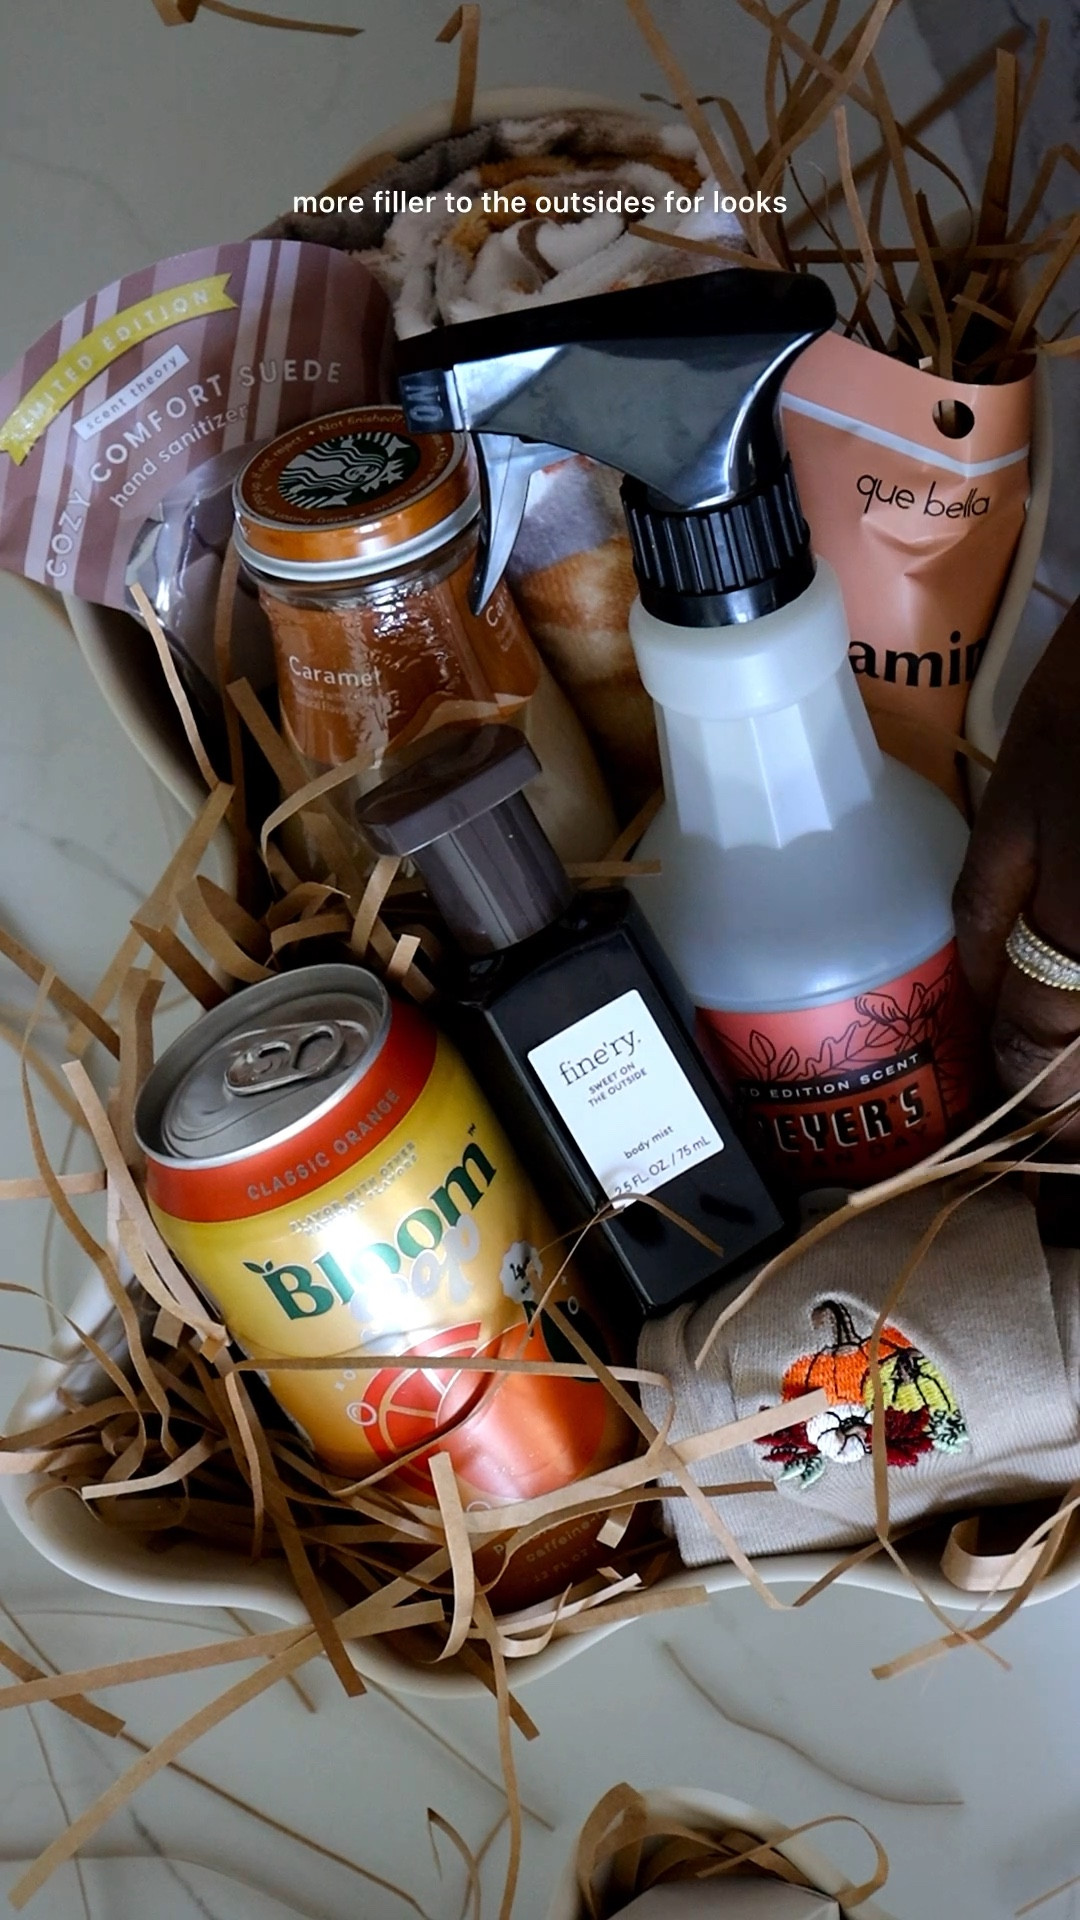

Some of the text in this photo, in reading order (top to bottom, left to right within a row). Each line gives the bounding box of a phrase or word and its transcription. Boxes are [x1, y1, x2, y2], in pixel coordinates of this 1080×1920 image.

[102, 291, 208, 351] EDITION
[86, 355, 178, 430] scent theory
[317, 412, 405, 432] Not finished?
[45, 359, 343, 577] COZY COMFORT SUEDE
[109, 403, 249, 508] hand sanitizer
[856, 474, 990, 518] que bella
[289, 655, 381, 687] Caramel
[588, 1068, 647, 1108] THE OUTSIDE
[589, 1062, 636, 1094] SWEET ON
[770, 1080, 850, 1098] EDITION
[859, 1053, 919, 1085] SCENT
[247, 1089, 400, 1201] CLASSIC ORANGE
[624, 1126, 674, 1159] body mist
[676, 1145, 692, 1160] 75
[692, 1136, 711, 1151] mL
[289, 1141, 415, 1234] FLAVOR WITH OTHER
[366, 1154, 417, 1198] FLAVORS
[264, 1140, 497, 1320] Bloom
